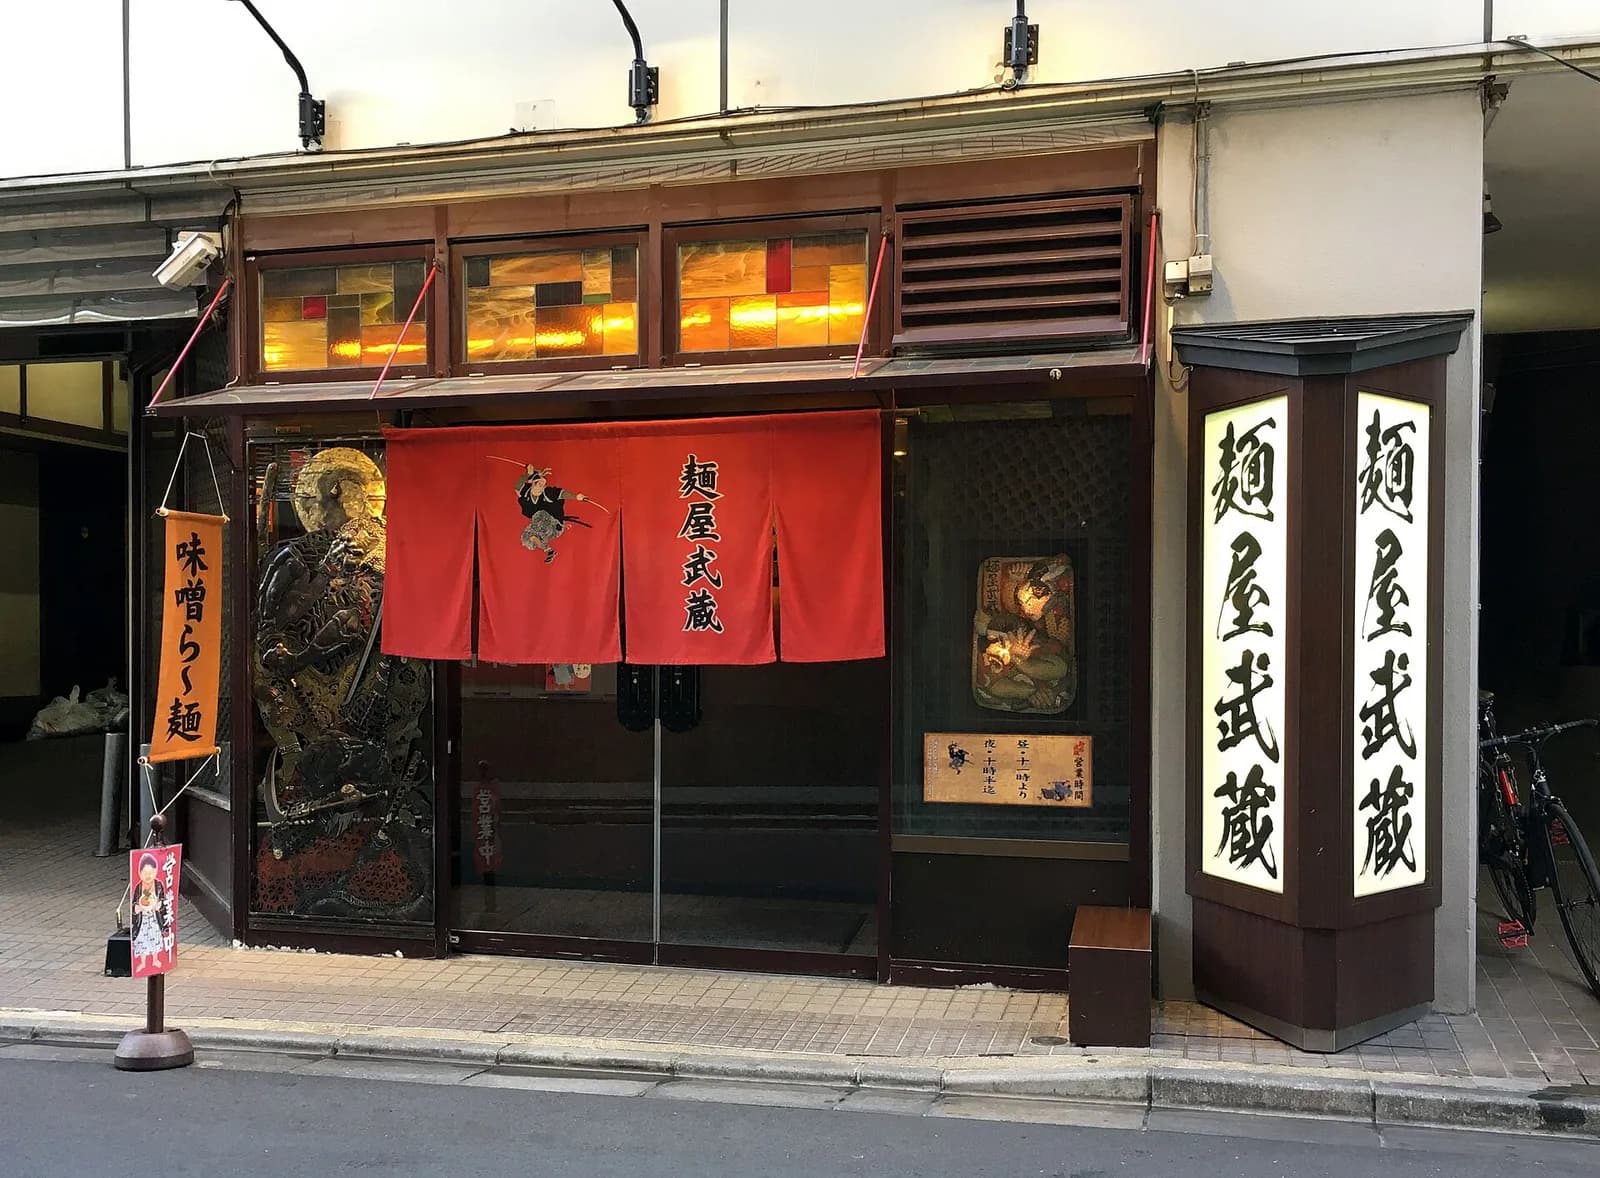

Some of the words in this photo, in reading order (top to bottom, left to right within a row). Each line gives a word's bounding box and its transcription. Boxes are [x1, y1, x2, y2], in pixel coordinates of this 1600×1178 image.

[677, 453, 725, 634] 麺屋武蔵
[1211, 417, 1280, 880] 麺屋武蔵
[1358, 408, 1417, 879] 麺屋武蔵
[1074, 757, 1085, 801] 営業時間
[162, 851, 177, 964] 営業中
